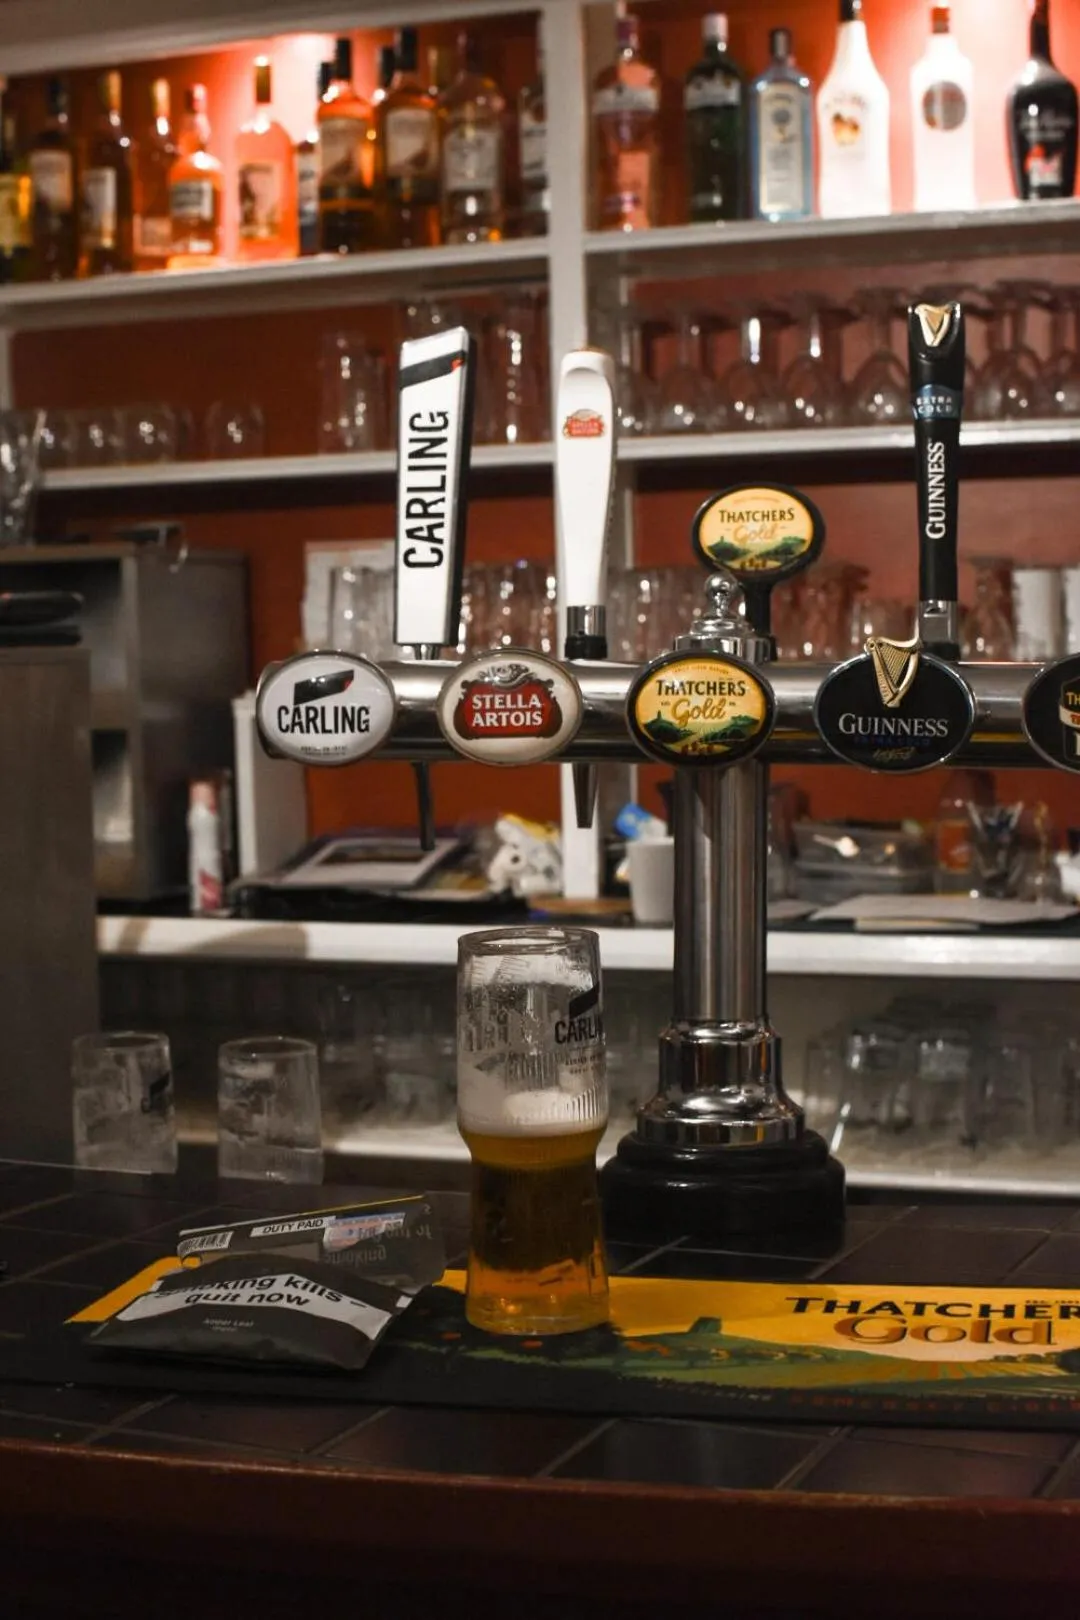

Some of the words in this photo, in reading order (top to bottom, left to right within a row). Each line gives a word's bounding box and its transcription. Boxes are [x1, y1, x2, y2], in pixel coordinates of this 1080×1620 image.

[403, 411, 449, 568] CARLING
[925, 441, 946, 539] GUINNESS
[719, 508, 795, 523] THATCHERS
[733, 522, 779, 545] Gold
[656, 679, 746, 697] THATCHERS
[472, 693, 542, 709] STELLA
[671, 698, 727, 728] Gold
[277, 705, 370, 734] CARLING
[472, 711, 543, 727] ARTOIS
[838, 712, 949, 738] GUINNESS
[263, 1224, 294, 1235] DUTY
[297, 1219, 324, 1230] PAID
[185, 1293, 242, 1304] quit
[248, 1292, 310, 1306] now
[284, 1276, 343, 1302] kills
[833, 1315, 1057, 1346] Gold
